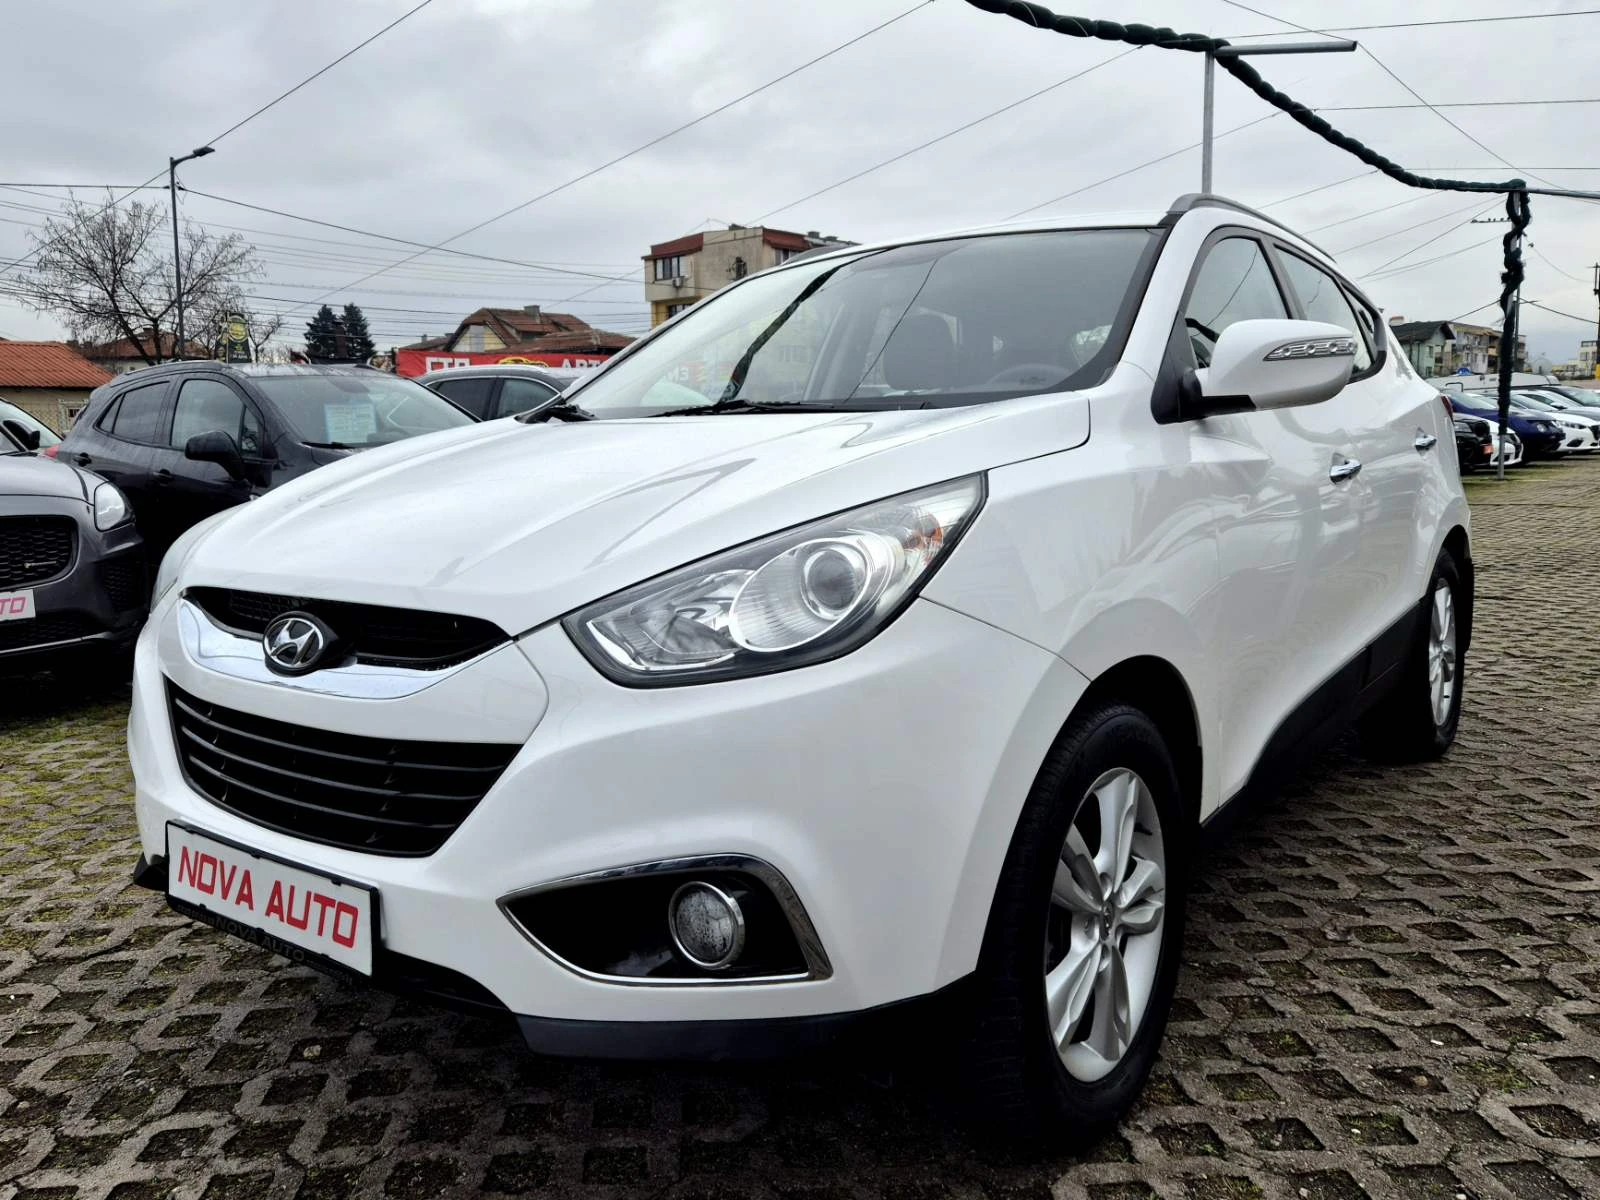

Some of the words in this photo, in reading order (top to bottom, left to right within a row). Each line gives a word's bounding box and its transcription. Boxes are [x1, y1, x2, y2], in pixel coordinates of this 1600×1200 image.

[177, 846, 254, 911] NOVA
[265, 880, 359, 948] AUTO
[215, 915, 258, 945] NOVA
[261, 935, 305, 963] AUTO
